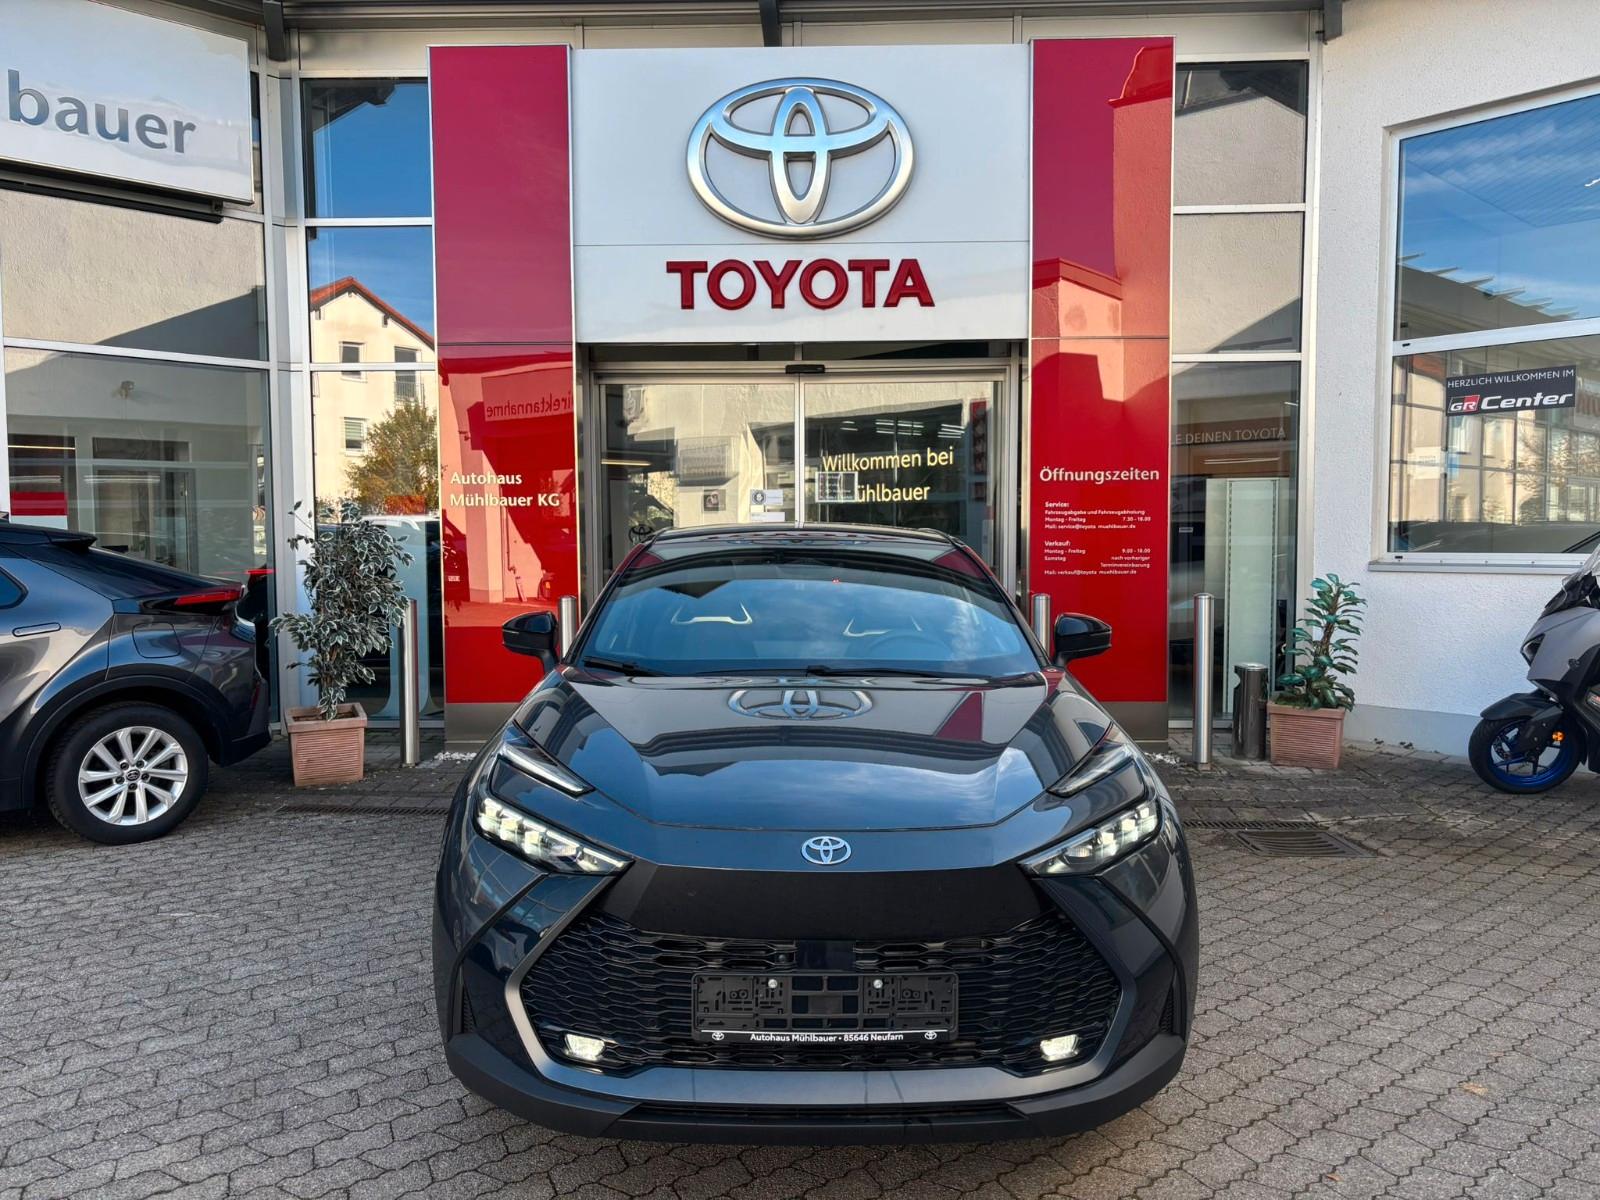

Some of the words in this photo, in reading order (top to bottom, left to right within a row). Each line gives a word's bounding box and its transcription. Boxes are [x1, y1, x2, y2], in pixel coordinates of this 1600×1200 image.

[8, 69, 196, 153] bauer
[666, 258, 936, 310] TOYOTA
[1447, 377, 1492, 388] HERZLICH
[1494, 371, 1560, 384] WILLKOMMEN
[1562, 369, 1574, 378] IM
[1450, 401, 1477, 412] GR
[1481, 392, 1573, 410] Center
[1185, 431, 1231, 444] DEINEN
[1235, 426, 1286, 440] TOYOTA
[822, 453, 922, 472] Willkommen
[926, 446, 954, 466] bei
[450, 472, 522, 485] Autohaus
[1039, 466, 1159, 485] Öffnungszeiten
[450, 493, 533, 507] Mühlbauer
[538, 494, 560, 507] KG
[857, 483, 931, 503] ühlbauer
[750, 1033, 790, 1042] Autohaus
[791, 1033, 837, 1043] Mühlbauer
[843, 1033, 869, 1042] 85646
[870, 1033, 904, 1042] Neufarn
